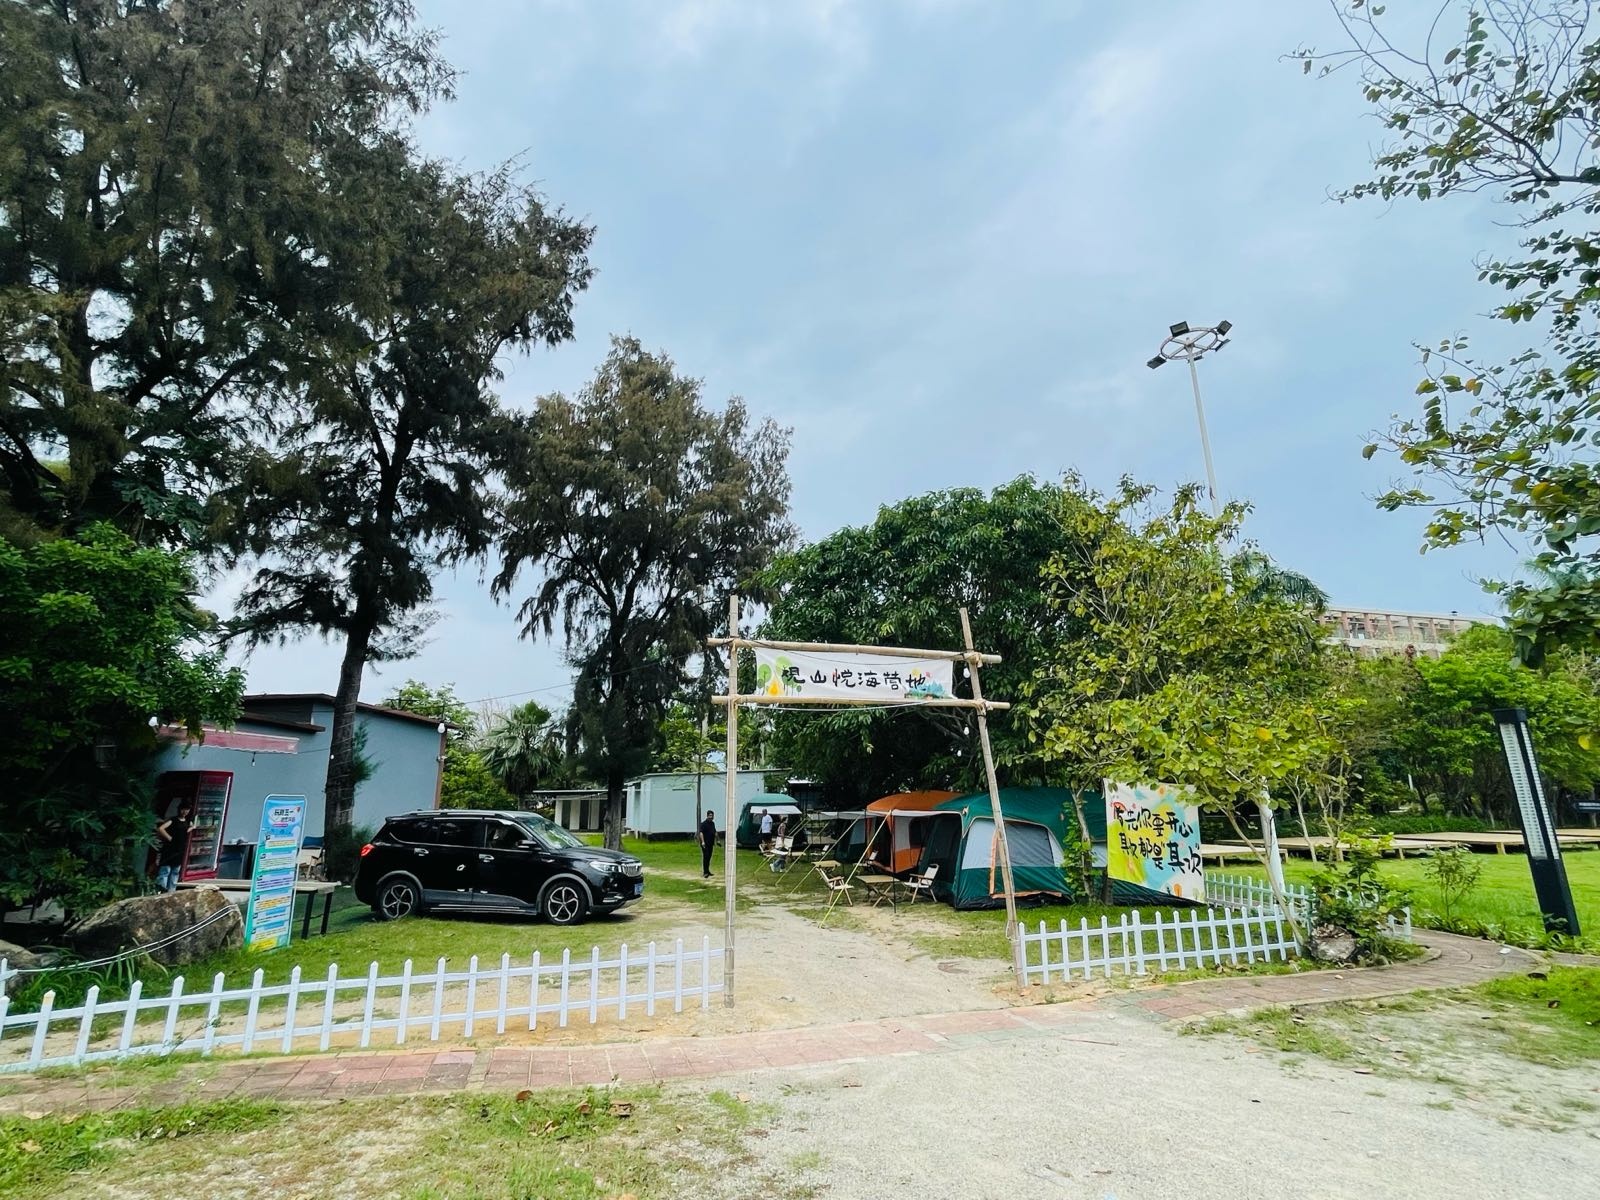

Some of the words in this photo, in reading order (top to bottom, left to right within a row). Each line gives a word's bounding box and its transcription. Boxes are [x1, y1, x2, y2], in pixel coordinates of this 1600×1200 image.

[781, 666, 926, 690] 观山悦海营地
